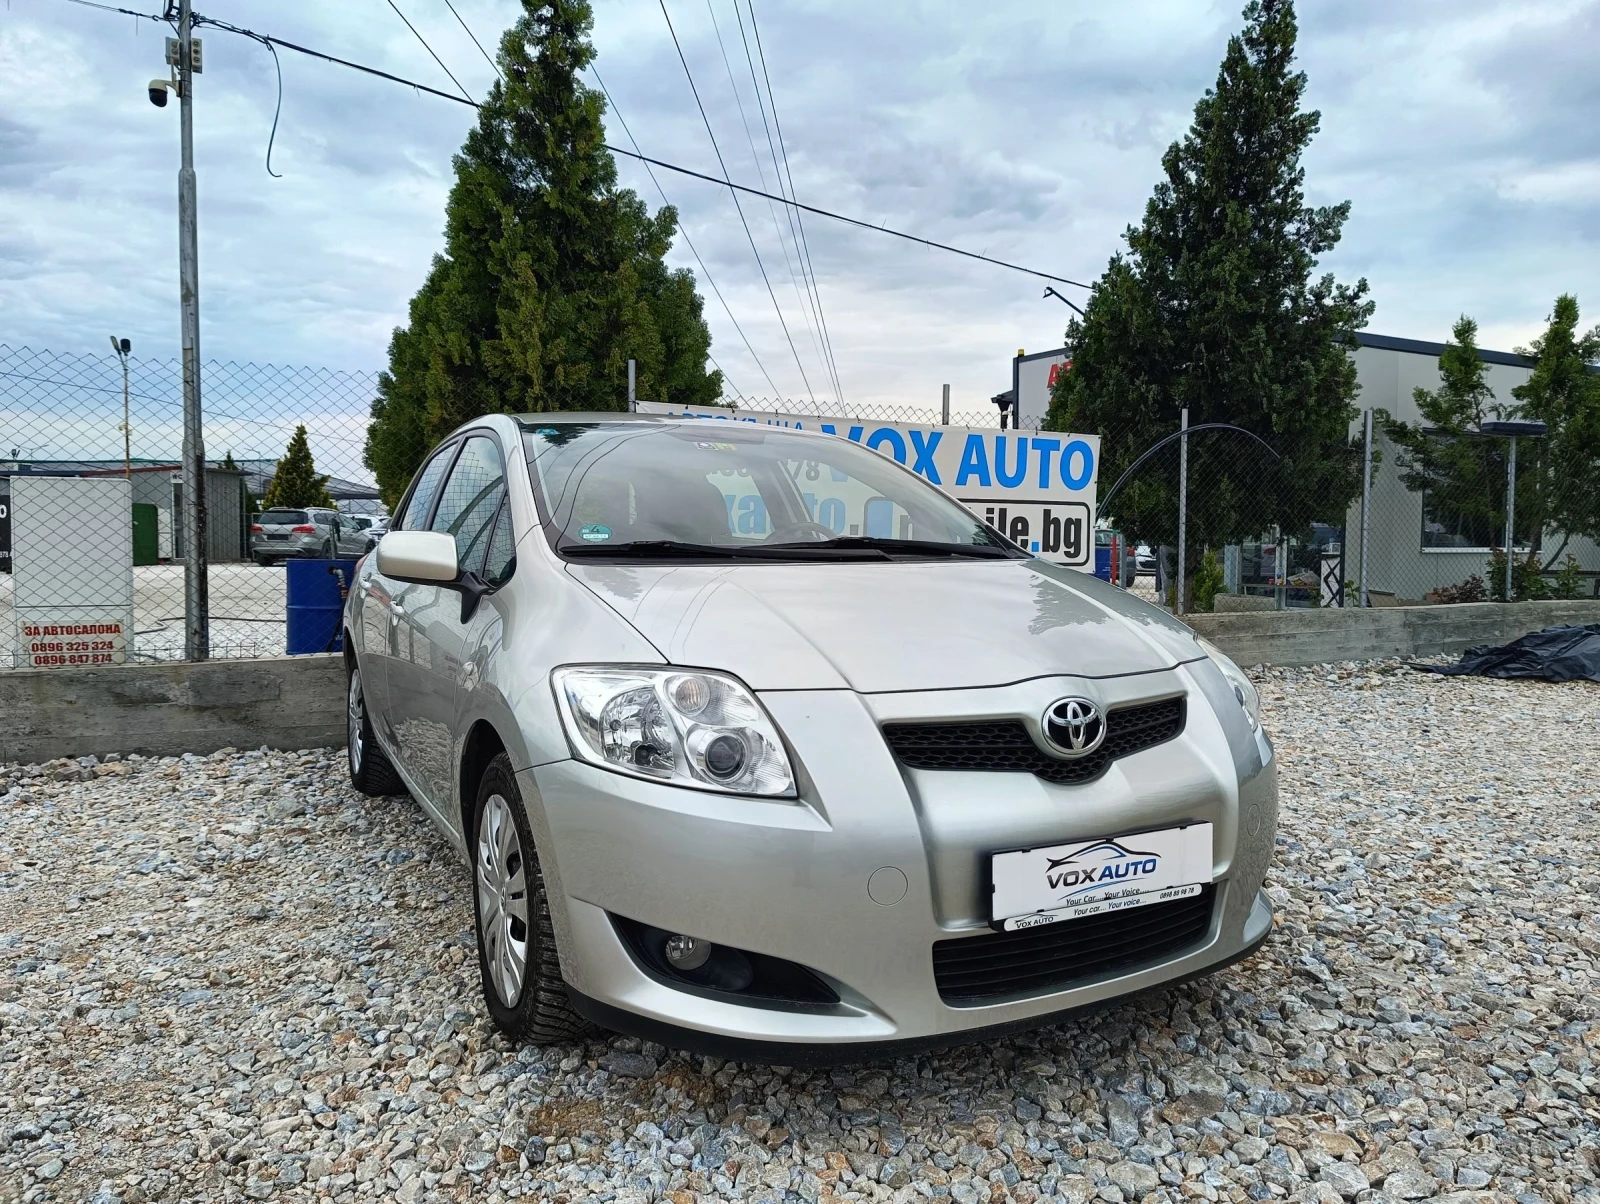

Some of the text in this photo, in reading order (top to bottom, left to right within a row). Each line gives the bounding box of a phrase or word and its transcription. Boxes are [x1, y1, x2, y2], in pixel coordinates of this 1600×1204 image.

[955, 434, 1094, 490] AUTO
[25, 624, 121, 636] ЗА АВТОСАЛОНА
[31, 641, 114, 652] 0896 325 324
[34, 653, 112, 665] 0896 847 874
[1066, 898, 1081, 906] Your
[1074, 908, 1088, 916] Your
[1108, 901, 1122, 909] Your
[1016, 916, 1054, 928] VOX AUTO
